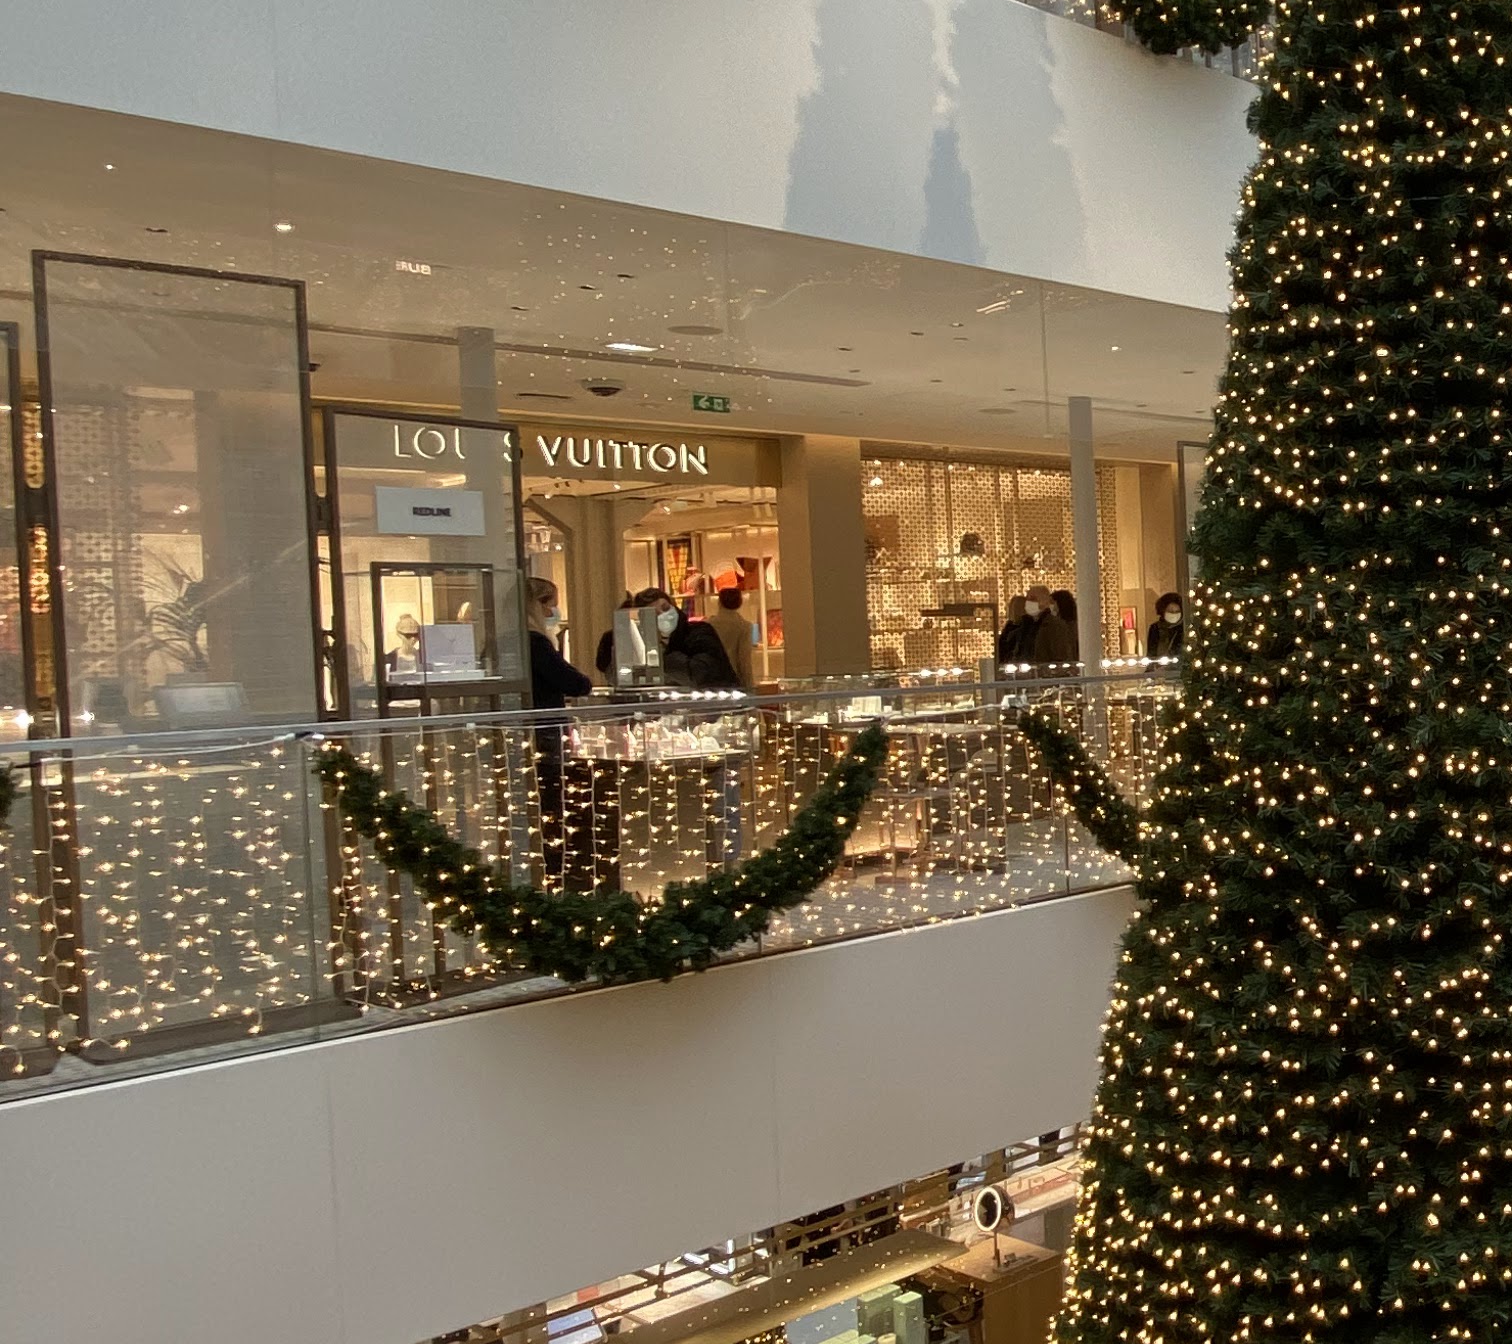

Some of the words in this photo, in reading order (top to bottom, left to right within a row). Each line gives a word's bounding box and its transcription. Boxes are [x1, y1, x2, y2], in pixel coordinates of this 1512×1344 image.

[394, 424, 517, 462] LOUS
[536, 434, 709, 476] VUITTON
[412, 506, 452, 517] REDLINE
